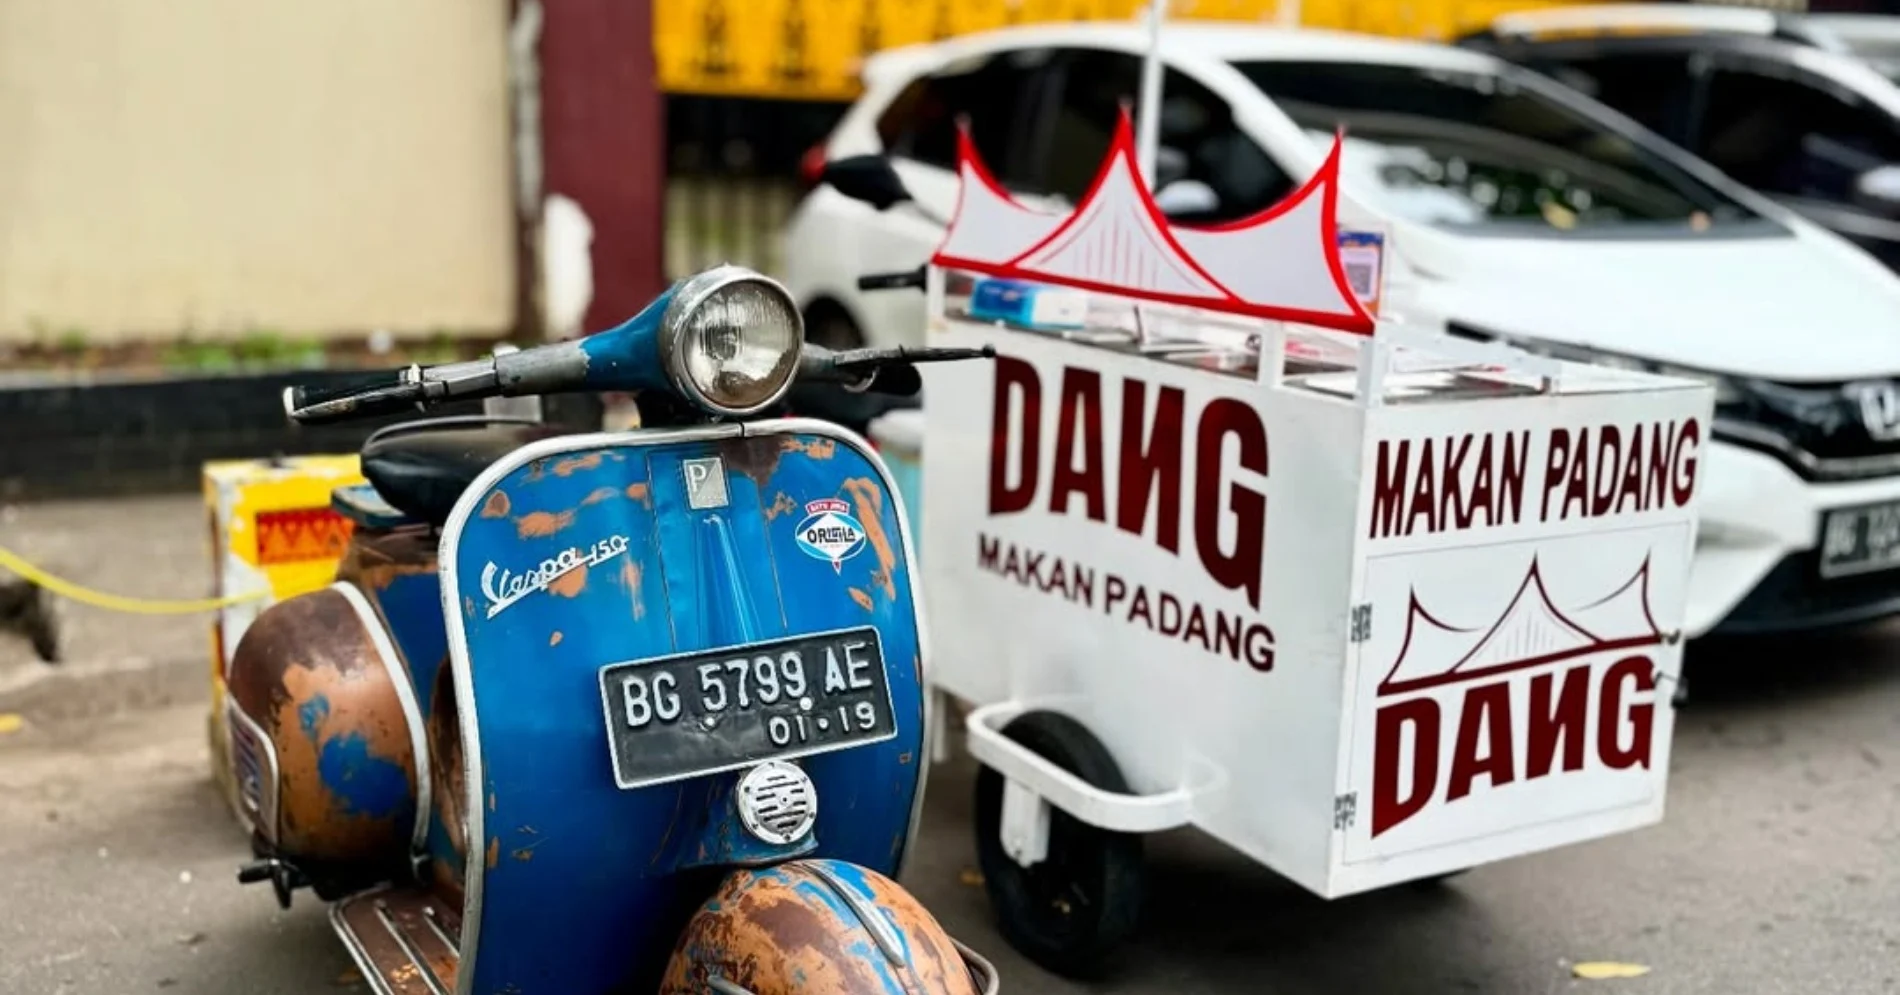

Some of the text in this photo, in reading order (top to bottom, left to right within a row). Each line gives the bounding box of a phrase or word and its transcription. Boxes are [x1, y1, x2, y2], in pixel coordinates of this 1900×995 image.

[1369, 418, 1699, 539] MAKAN PADANG
[481, 547, 586, 620] Vespa
[977, 531, 1276, 673] MAKAN PADANG
[622, 641, 873, 727] BG 5799 AE
